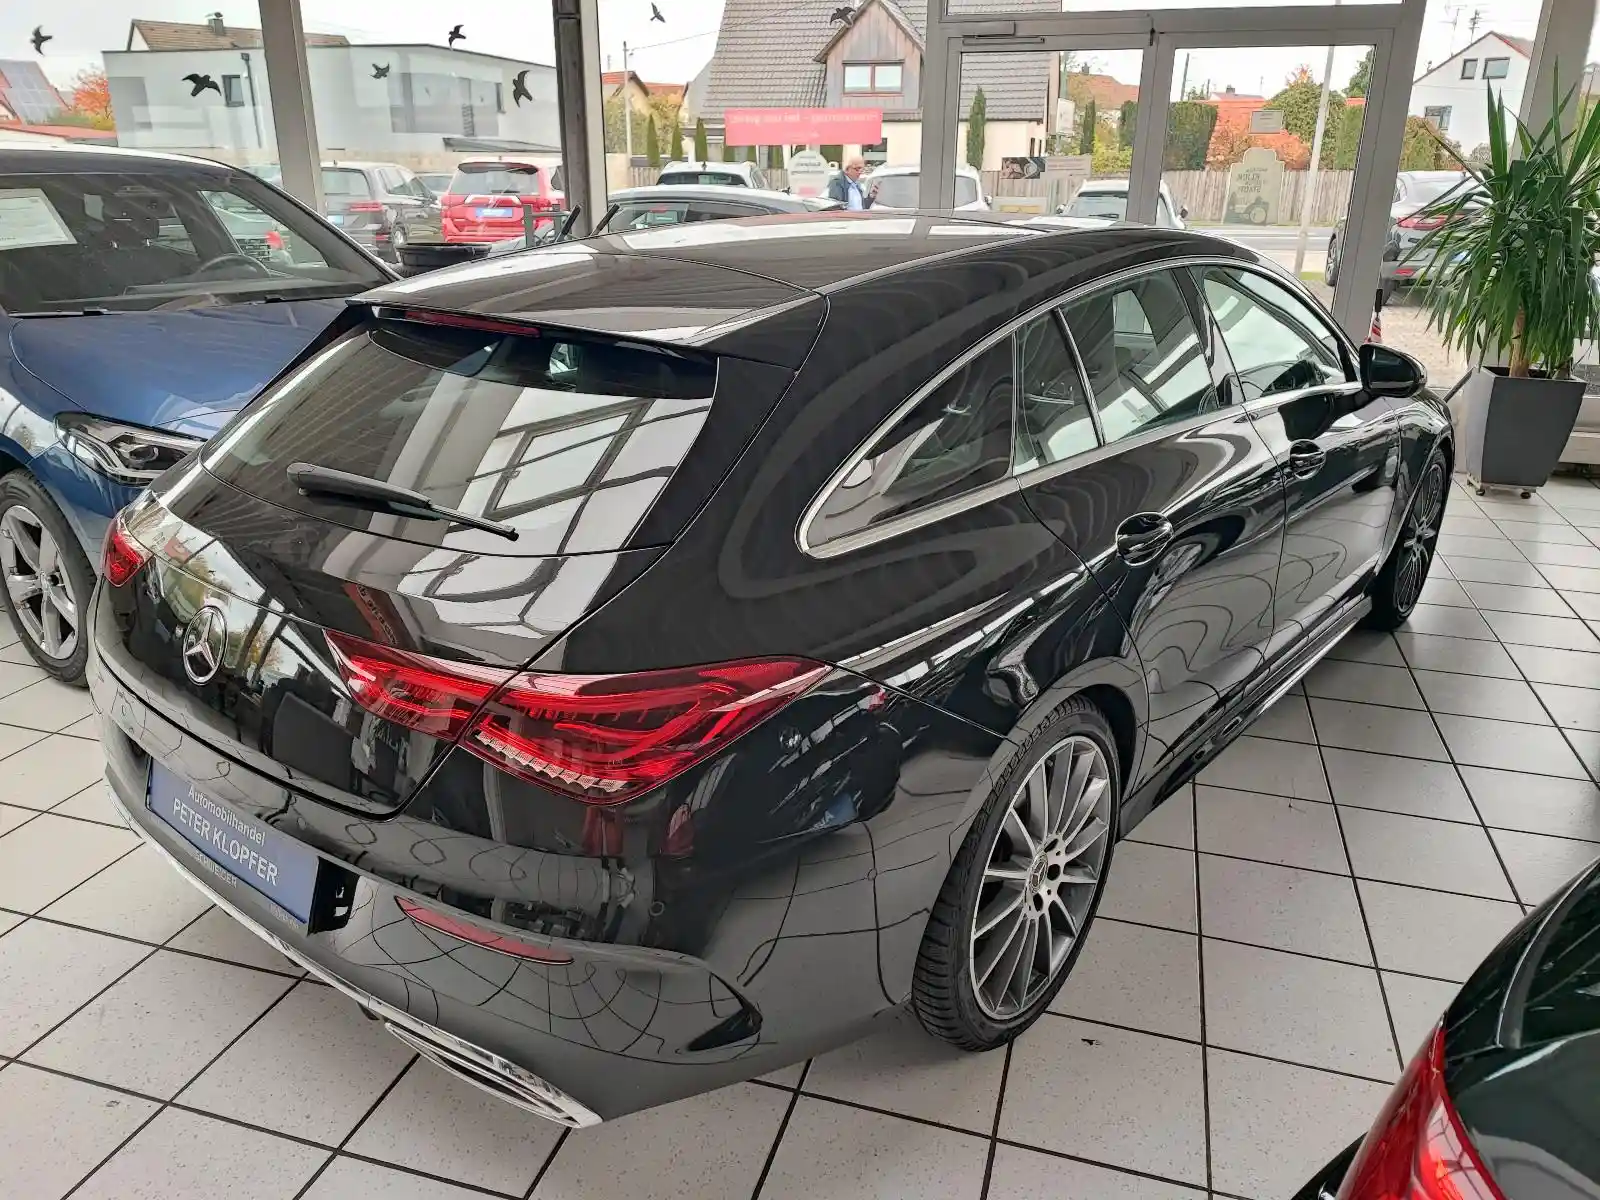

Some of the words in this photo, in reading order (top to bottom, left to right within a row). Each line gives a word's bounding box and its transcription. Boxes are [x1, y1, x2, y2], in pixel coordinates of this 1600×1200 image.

[172, 797, 210, 841] PETER
[213, 825, 279, 887] KLOPFER
[188, 784, 266, 847] Automobilhandel
